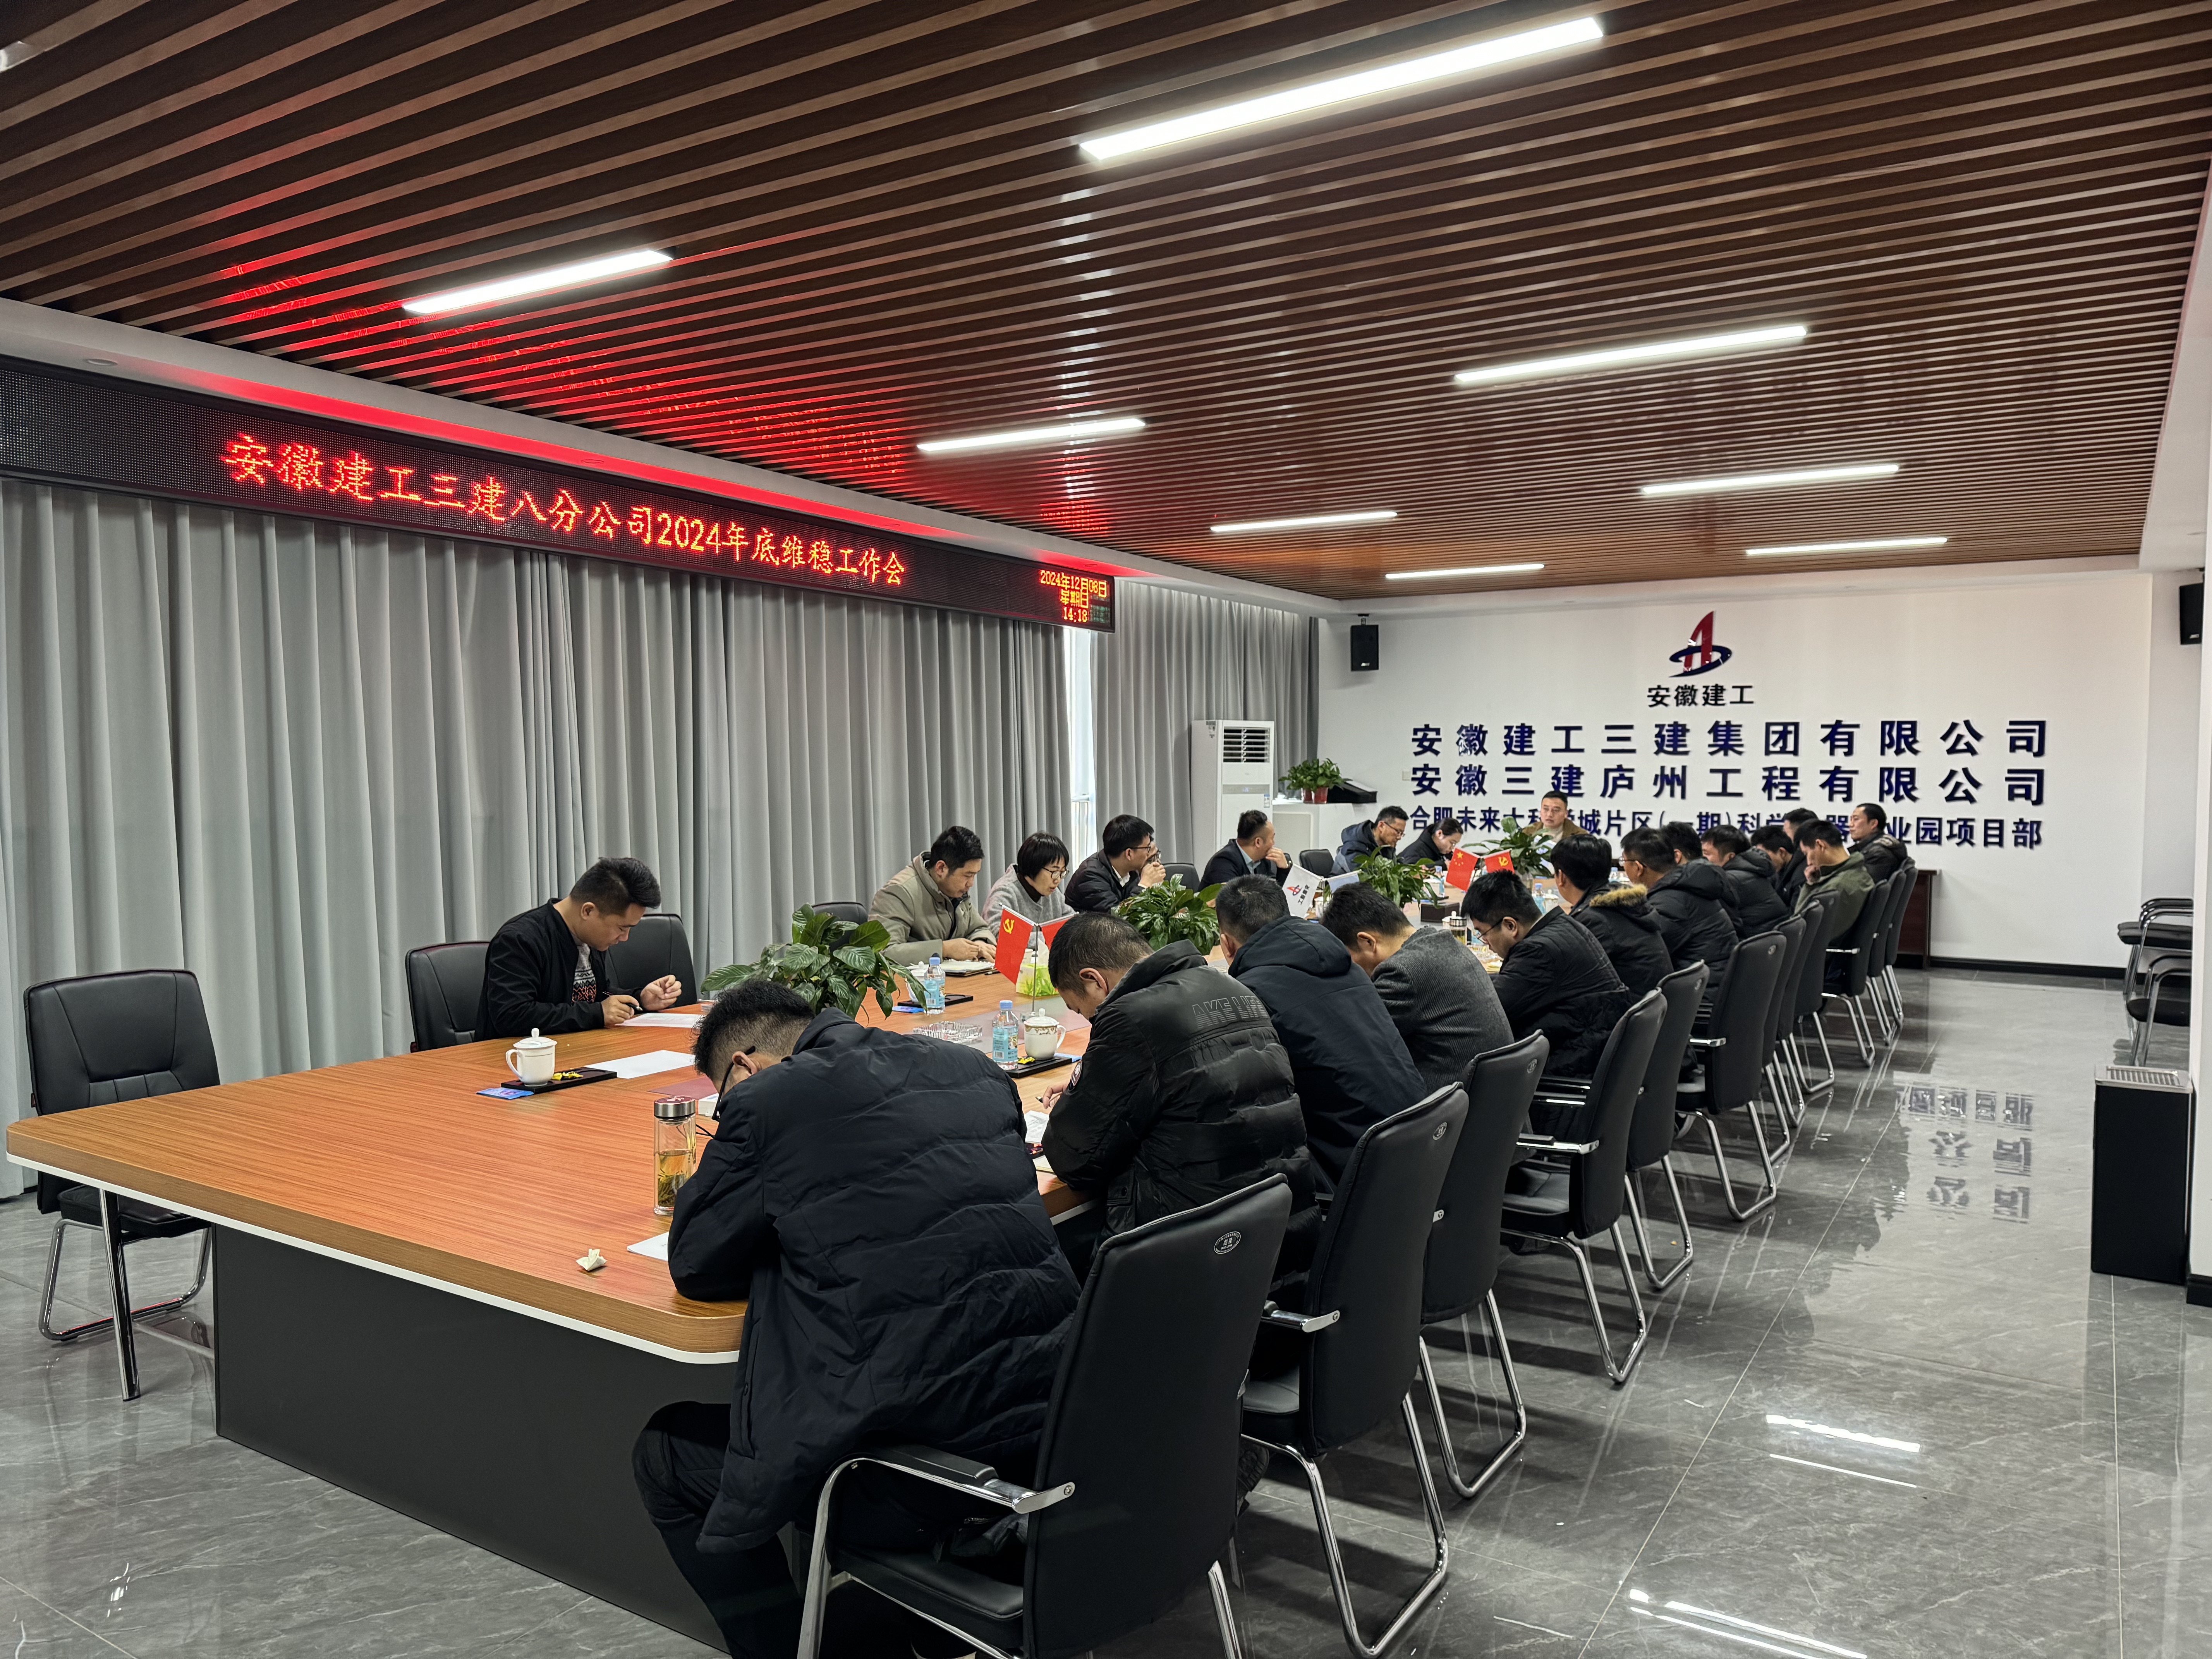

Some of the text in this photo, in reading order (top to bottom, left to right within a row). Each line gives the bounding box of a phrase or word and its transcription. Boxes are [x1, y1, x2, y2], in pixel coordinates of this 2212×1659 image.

[220, 432, 905, 585] 安徽建工三建八分公司2024年底维稳工作会
[1040, 569, 1107, 598] 2024年12月08日
[1060, 589, 1089, 608] 星期日
[1063, 606, 1088, 622] 14:18
[1647, 684, 1754, 708] 安徽建工
[1412, 719, 2046, 757] 安徽建工三建集团有限公司
[1411, 763, 2044, 806] 安徽三建庐州工程有限公司
